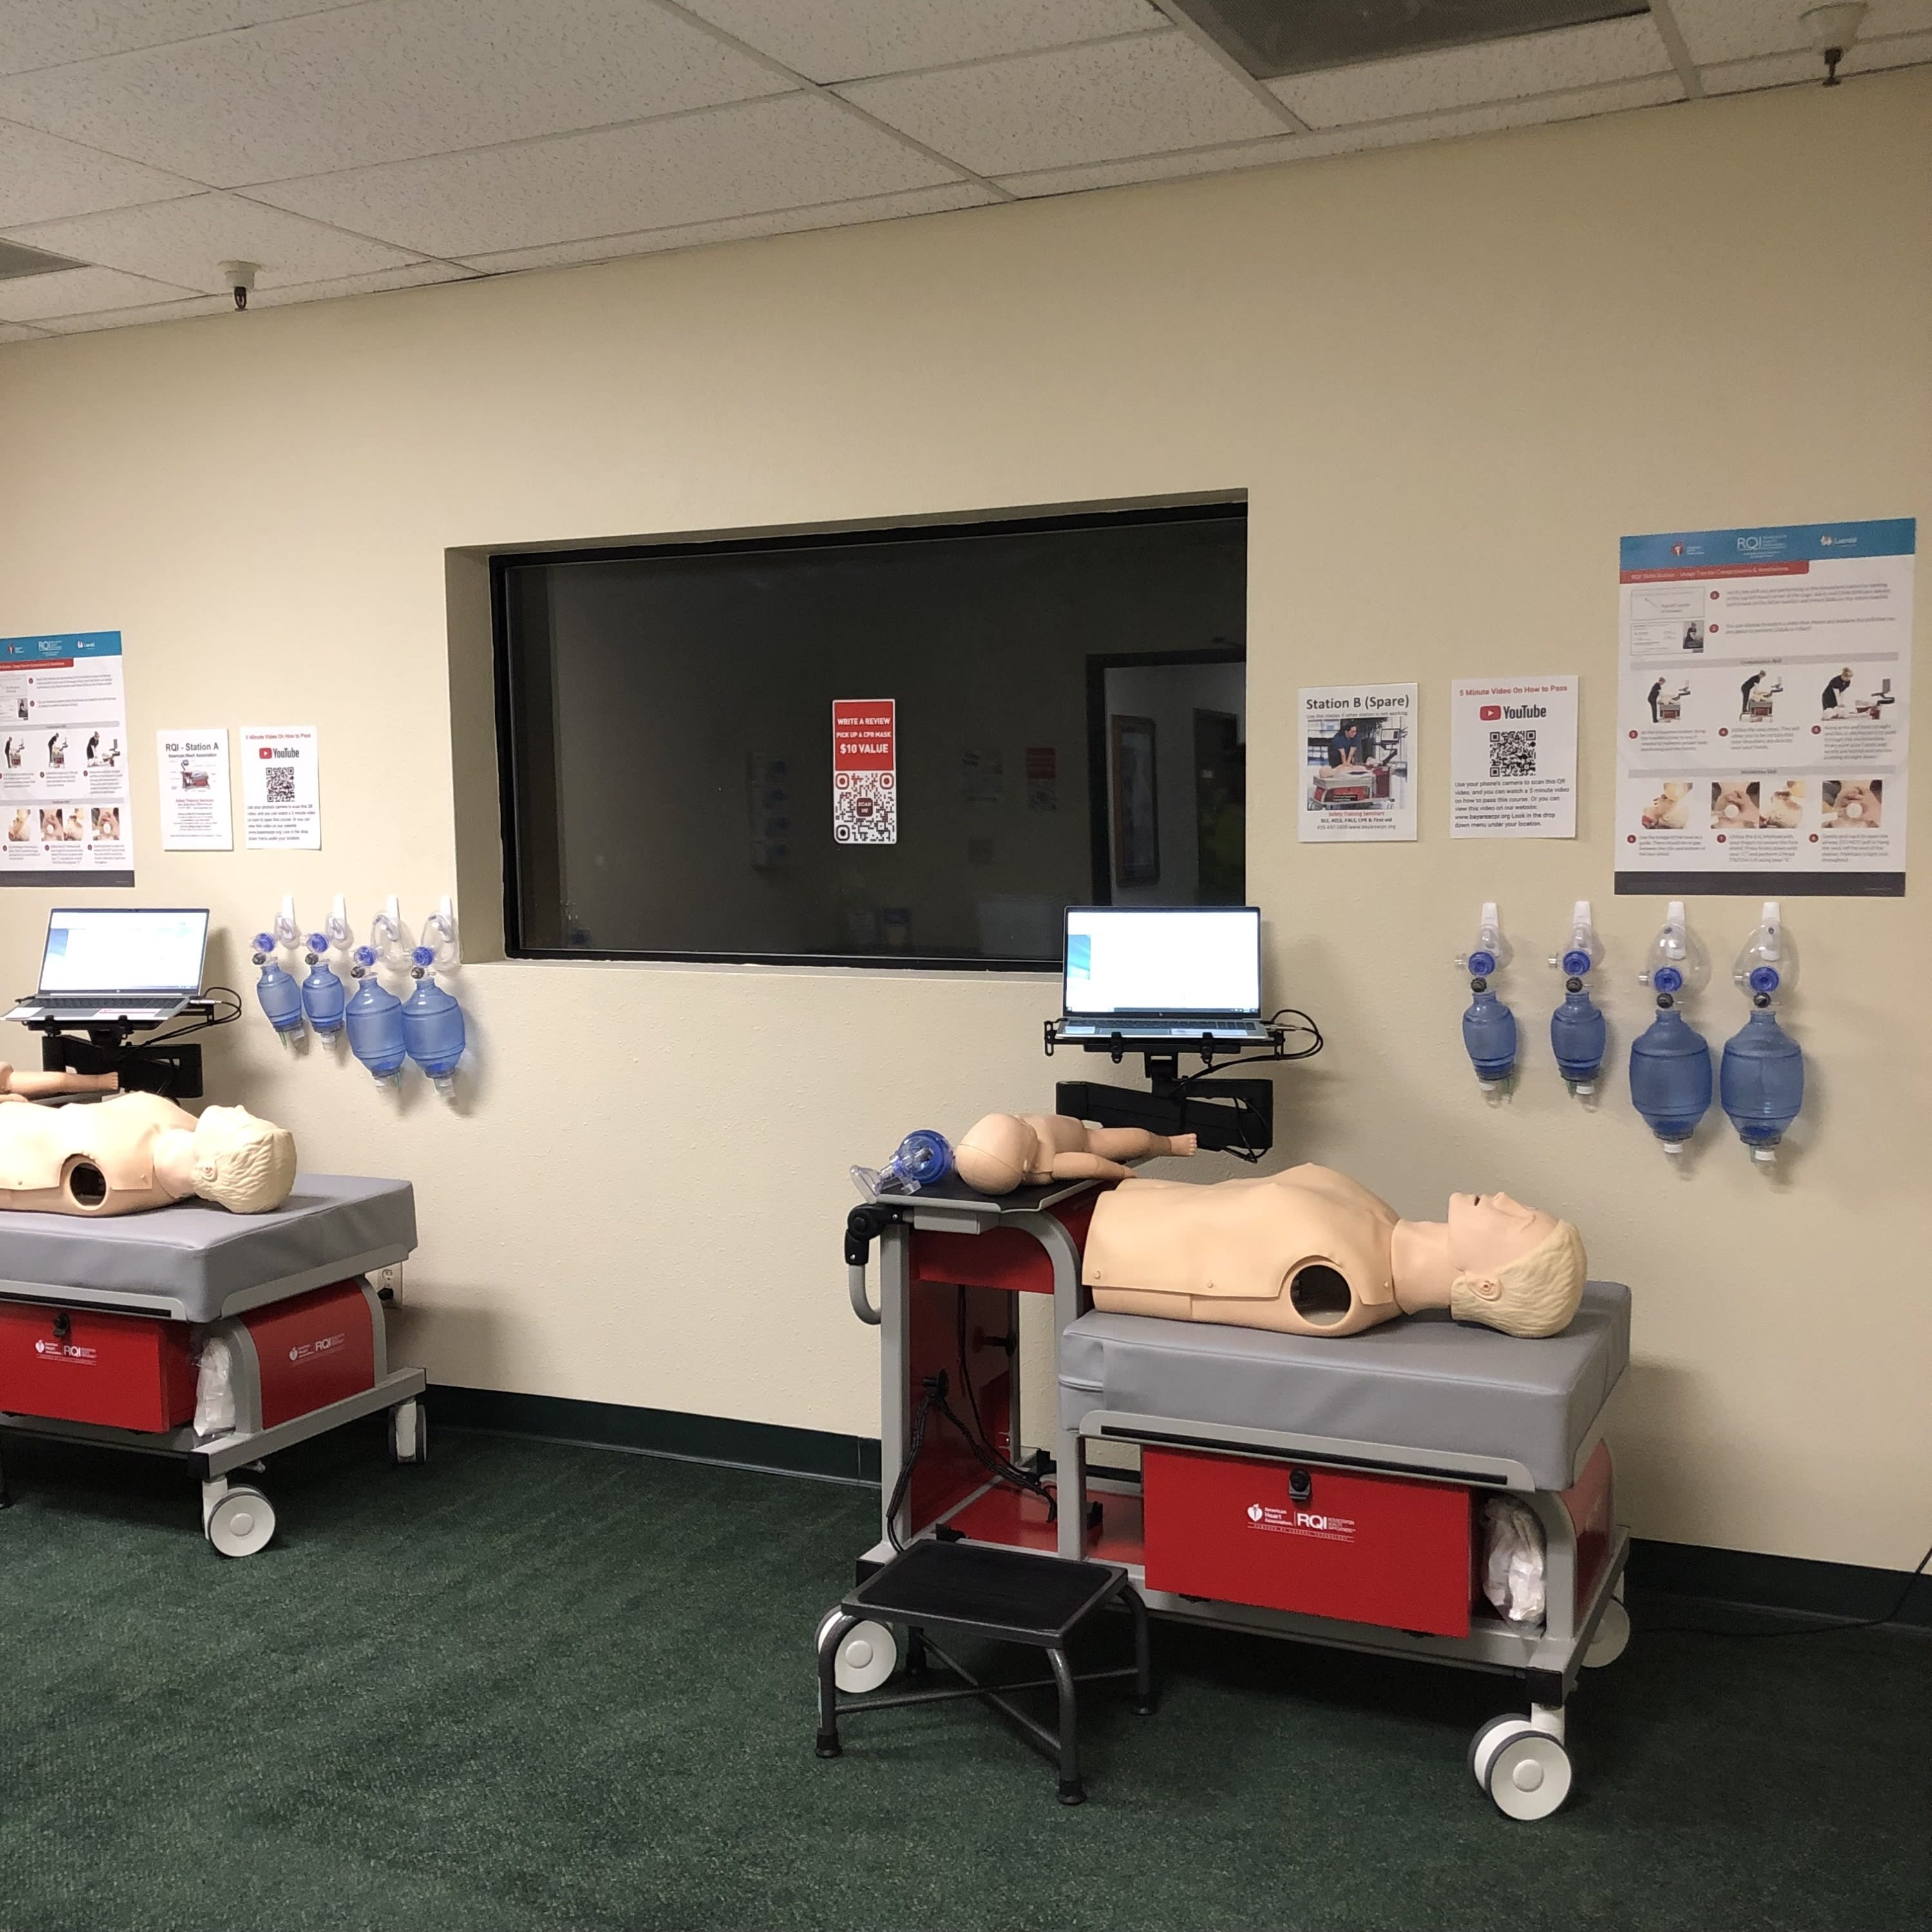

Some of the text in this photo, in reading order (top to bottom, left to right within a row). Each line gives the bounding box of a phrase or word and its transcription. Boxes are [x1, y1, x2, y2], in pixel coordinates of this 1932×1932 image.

[1737, 536, 1762, 550] RQI
[1306, 694, 1409, 710] Station B (Spare)
[1503, 704, 1547, 719] YouTube
[166, 743, 179, 752] RQI
[185, 743, 211, 752] Station
[213, 742, 219, 750] A
[272, 747, 299, 759] YouTube
[840, 743, 889, 755] $10 VALUE
[64, 1345, 81, 1358] RQI
[315, 1338, 332, 1352] RQI
[1297, 1513, 1327, 1530] RQI
